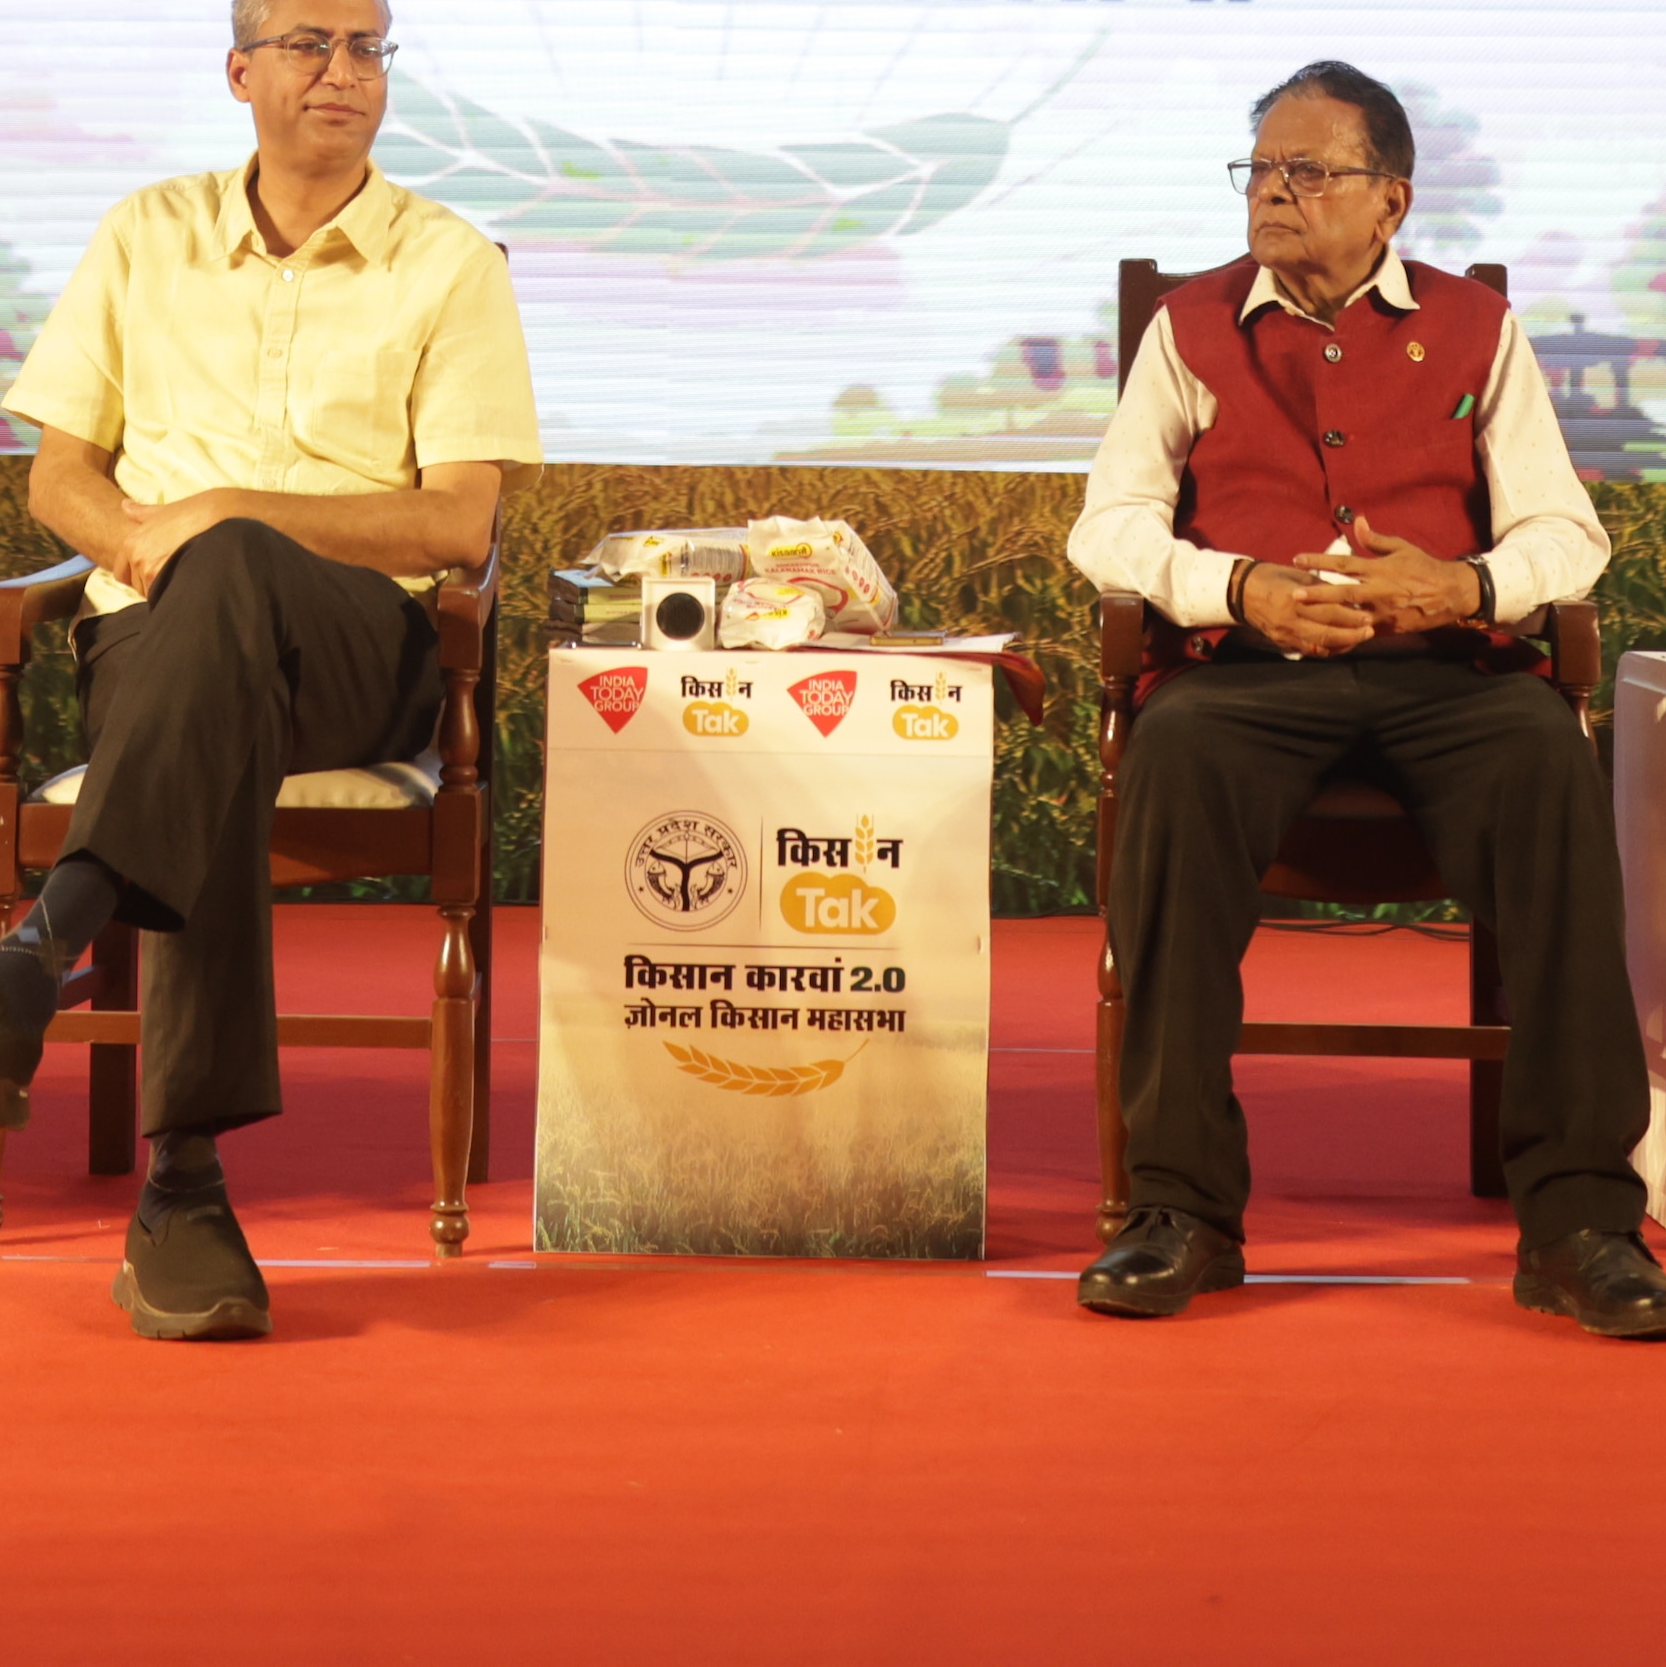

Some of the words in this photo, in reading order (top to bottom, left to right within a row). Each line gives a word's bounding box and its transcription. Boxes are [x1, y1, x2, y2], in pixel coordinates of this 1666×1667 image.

[599, 676, 635, 687] INDIA
[808, 680, 844, 691] INDIA
[590, 686, 644, 700] TODAY
[799, 691, 853, 704] TODAY
[594, 700, 639, 712] GROUP
[803, 704, 848, 716] GROUP
[692, 709, 739, 733] Tak
[901, 713, 948, 736] Tak
[796, 888, 879, 928] Tak
[624, 954, 736, 990] किसान
[745, 957, 844, 992] कारवां
[850, 967, 906, 992] 2.0
[710, 1000, 799, 1030] किसान
[807, 1008, 906, 1032] महासभा
